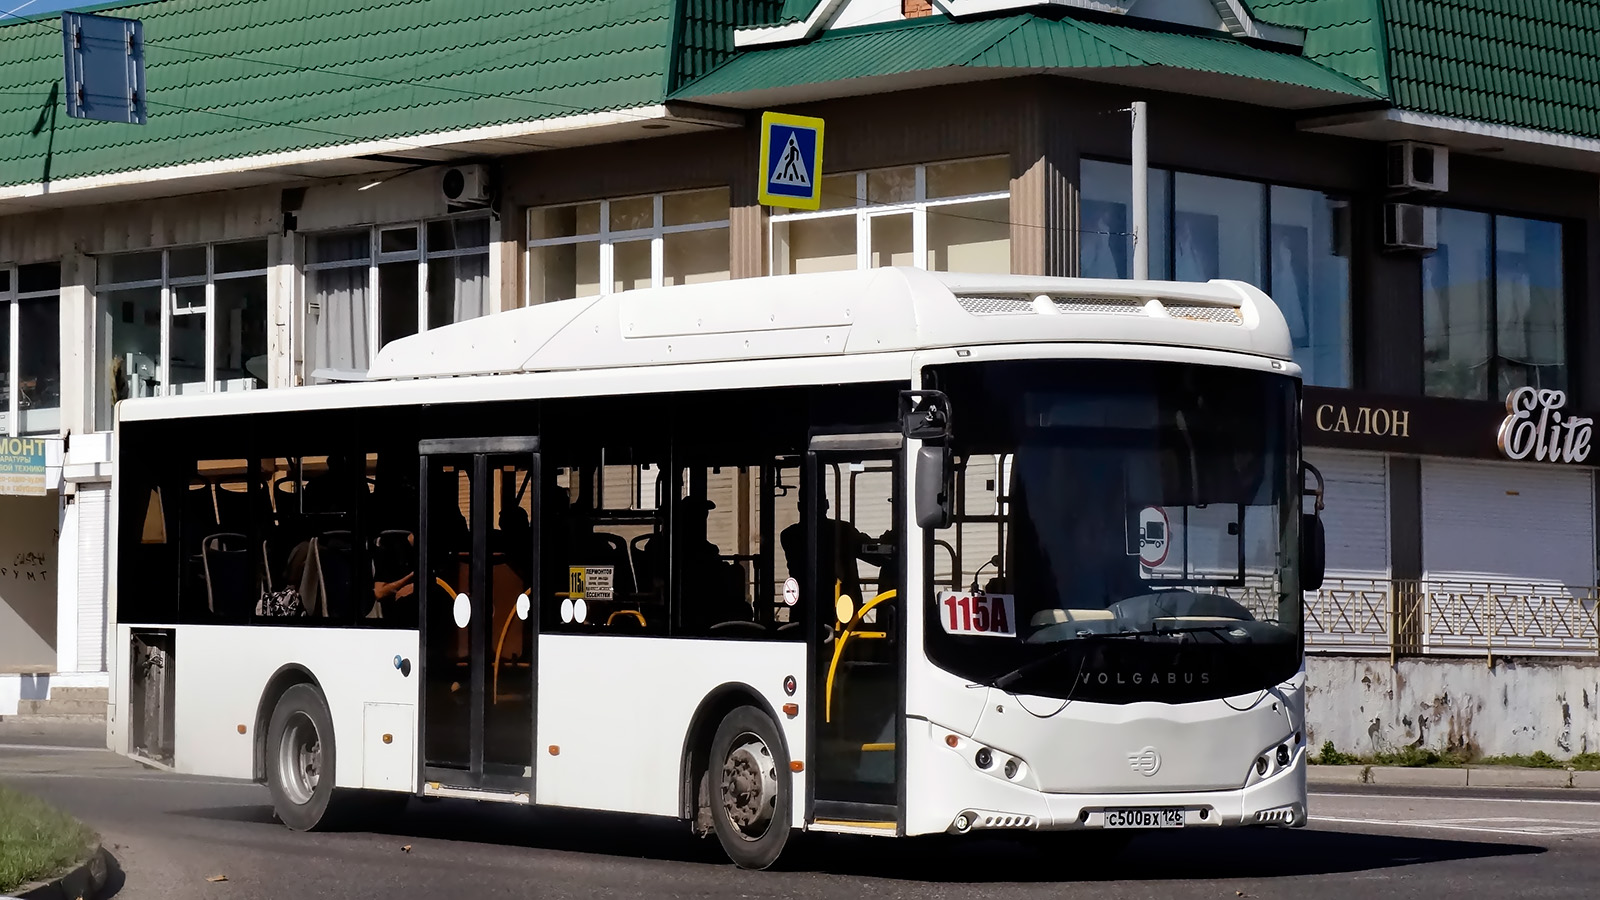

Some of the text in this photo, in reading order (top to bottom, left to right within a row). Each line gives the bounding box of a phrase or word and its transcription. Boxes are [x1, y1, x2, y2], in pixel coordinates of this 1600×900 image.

[1315, 404, 1410, 438] САЛОН
[1498, 386, 1593, 463] Elite
[944, 595, 1009, 633] 115А
[1081, 672, 1210, 685] VOLGABUS
[1163, 808, 1181, 821] 126
